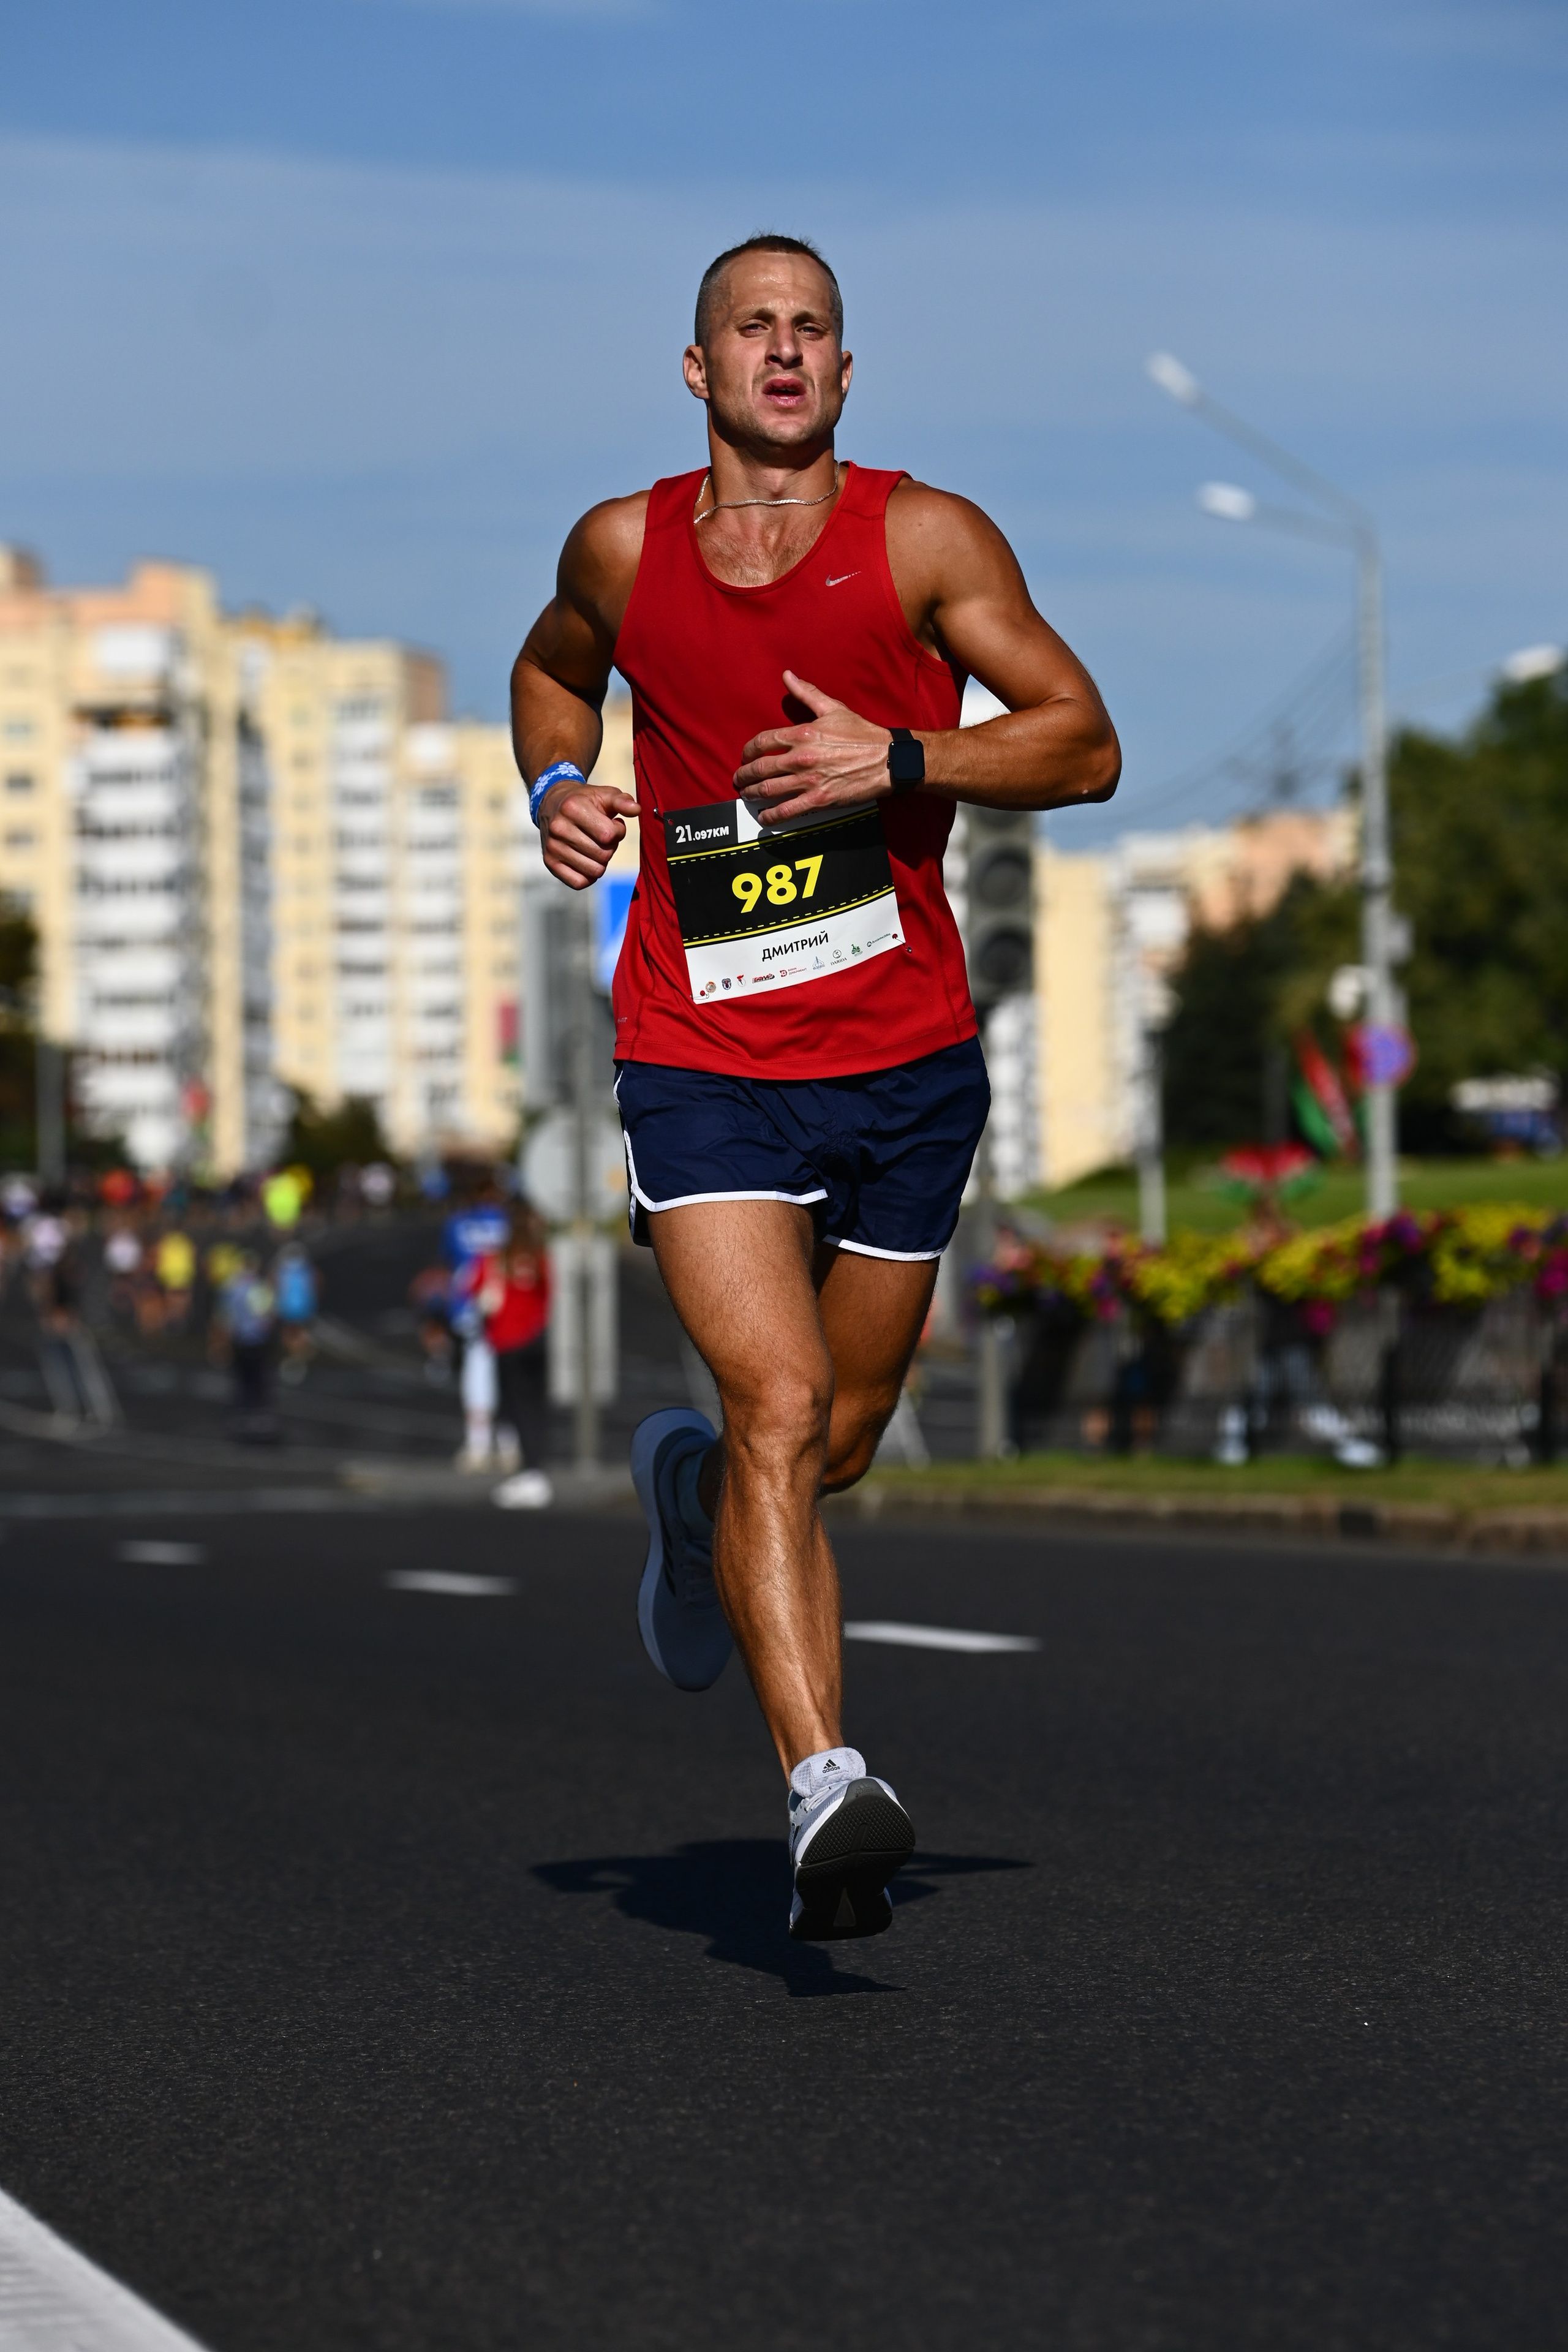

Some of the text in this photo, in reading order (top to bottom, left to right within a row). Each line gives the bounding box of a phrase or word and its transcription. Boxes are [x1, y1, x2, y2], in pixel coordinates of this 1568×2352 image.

[731, 854, 824, 913] 987
[762, 930, 829, 962] ДМИТРИЙ
[822, 1765, 841, 1774] adidas
